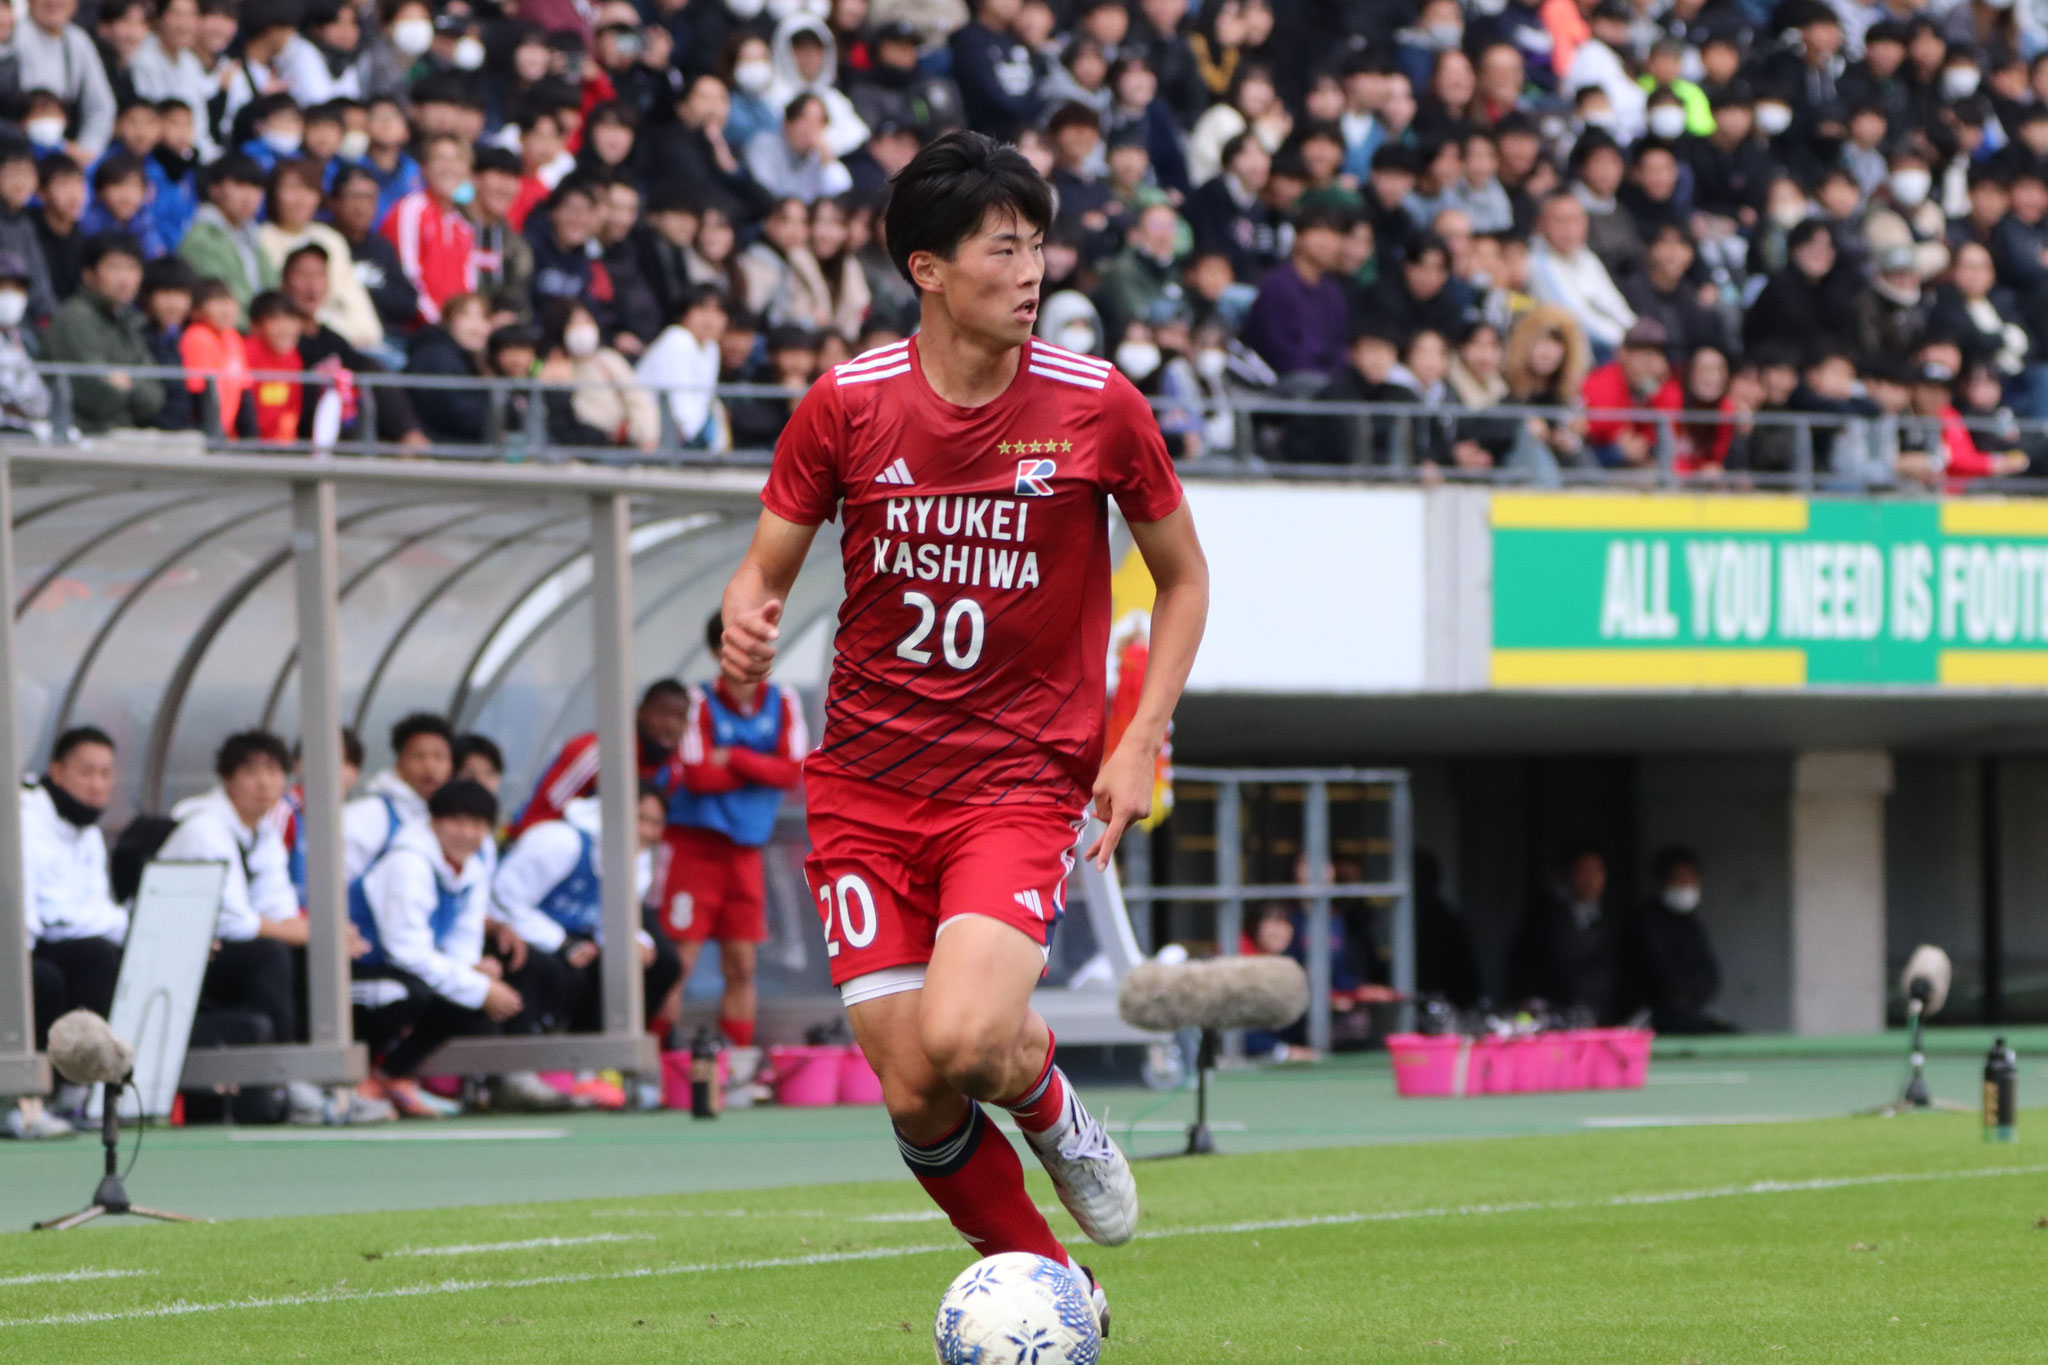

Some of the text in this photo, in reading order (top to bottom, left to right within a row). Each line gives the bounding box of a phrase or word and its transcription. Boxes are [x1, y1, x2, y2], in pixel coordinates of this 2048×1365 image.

[886, 497, 1029, 542] RYUKEI
[873, 536, 1040, 590] KASHIWA
[1601, 541, 1679, 640] ALL
[1686, 541, 1773, 642] YOU
[1779, 542, 1885, 641] NEED
[1891, 542, 1934, 642] IS
[896, 591, 986, 671] 20
[819, 873, 878, 959] 20
